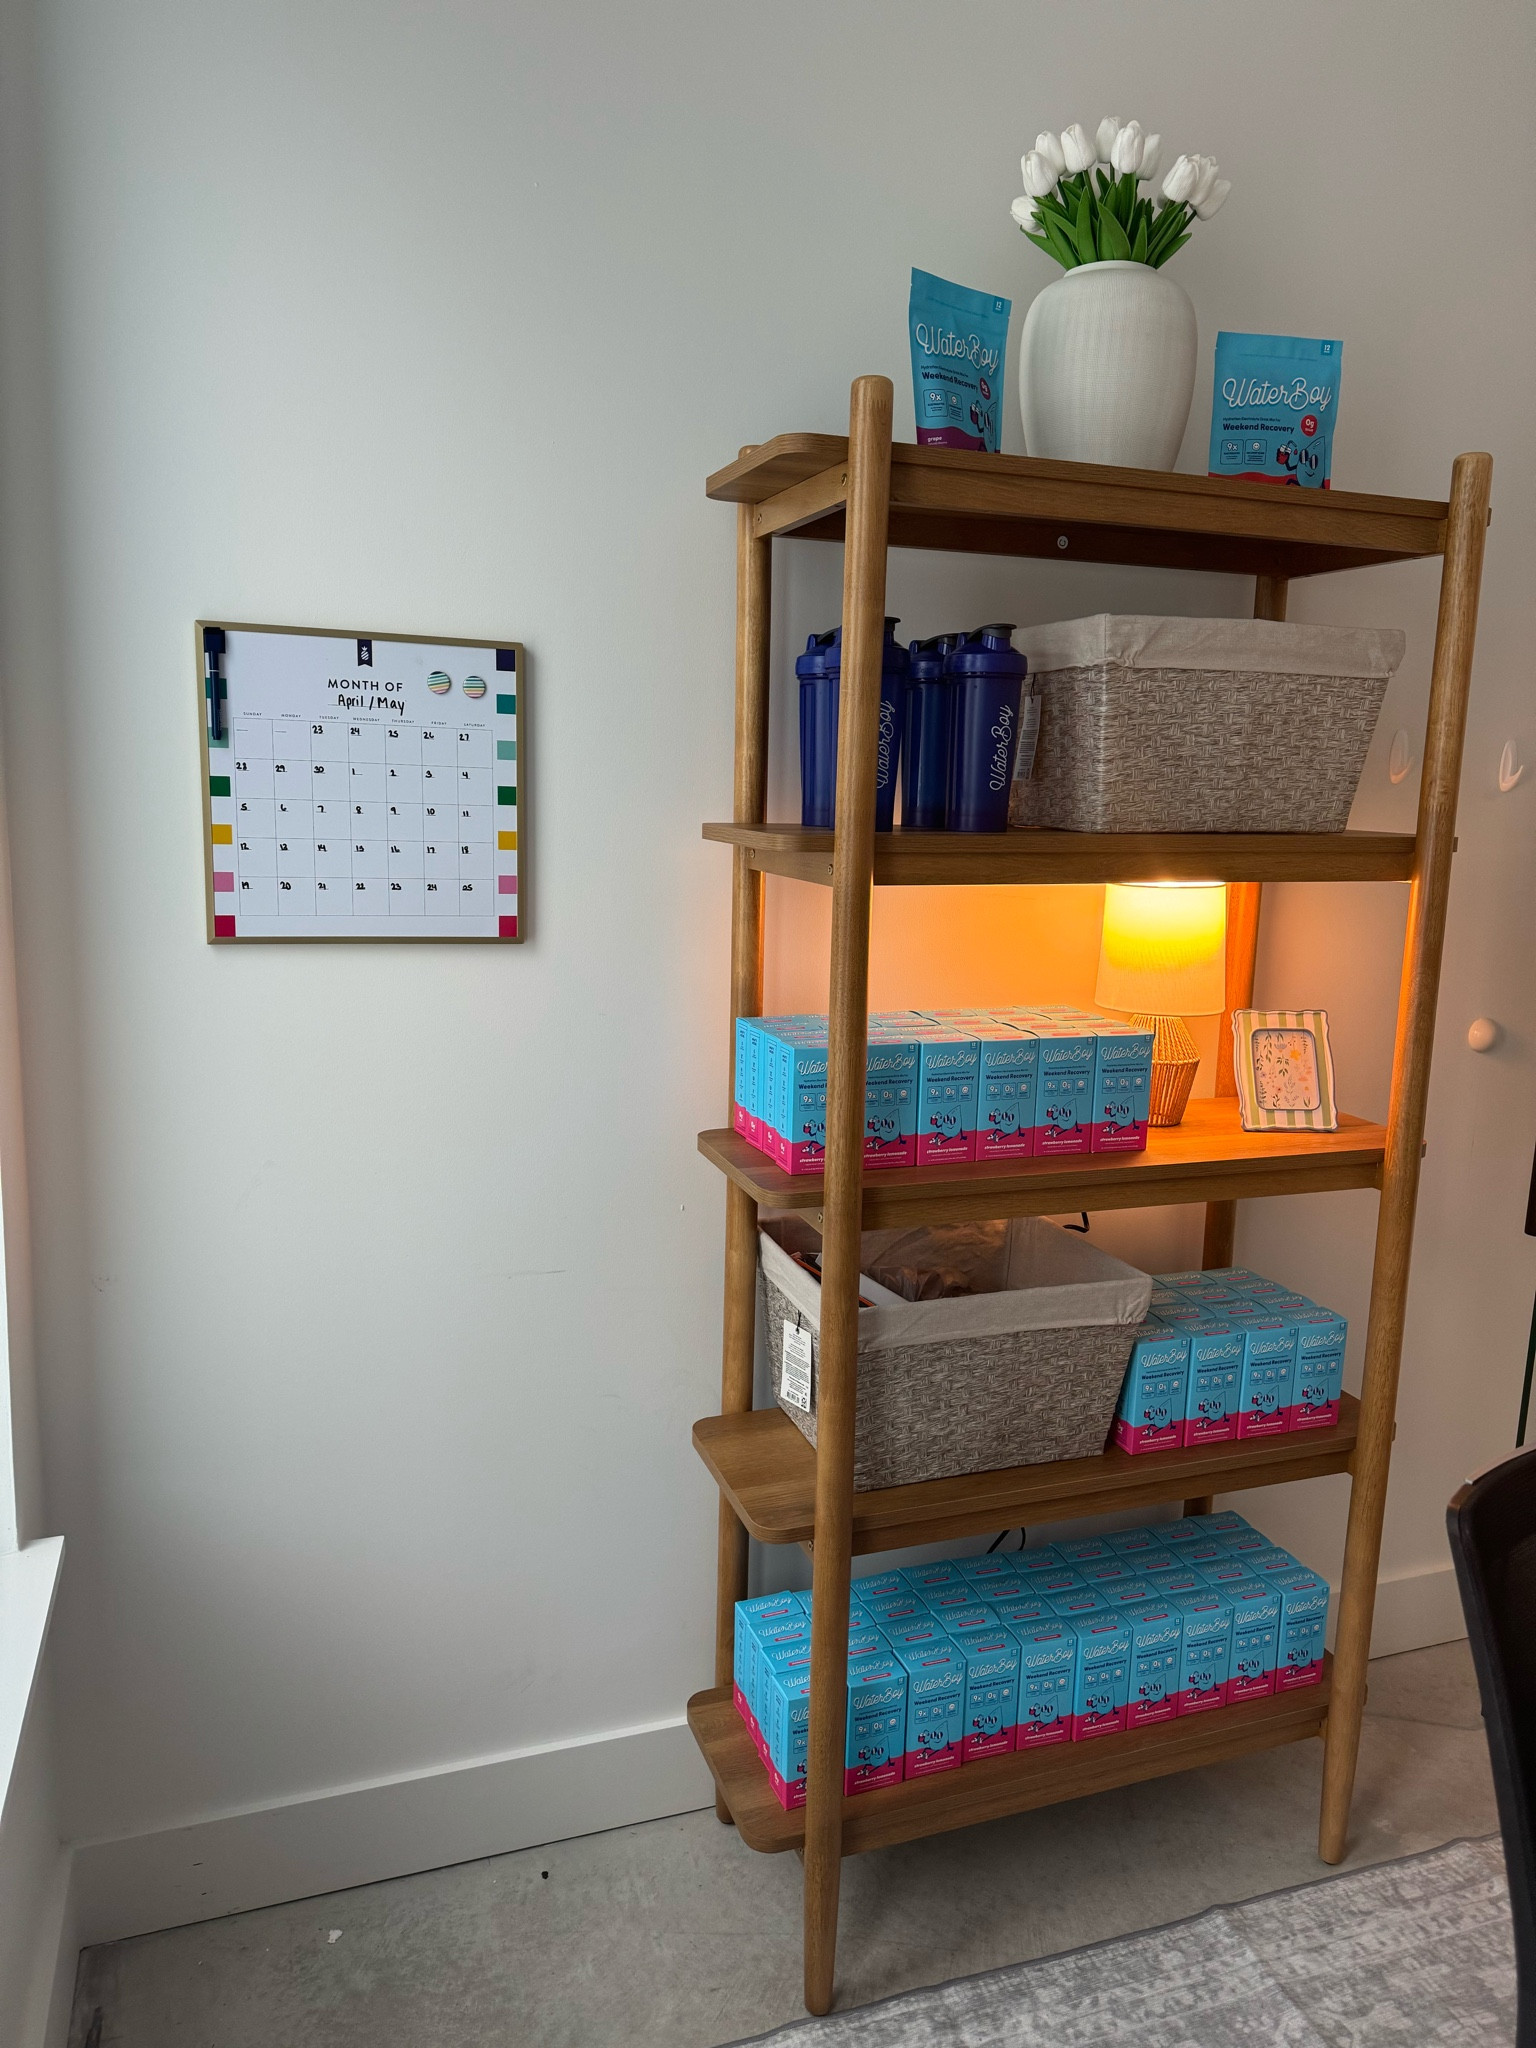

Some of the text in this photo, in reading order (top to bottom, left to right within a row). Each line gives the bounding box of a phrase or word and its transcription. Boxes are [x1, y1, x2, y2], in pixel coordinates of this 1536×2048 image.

[916, 323, 999, 376] WaterBoy
[921, 372, 953, 383] Weekend
[929, 392, 942, 401] 9x
[1222, 377, 1332, 411] WaterBoy
[1223, 423, 1259, 431] Weekend
[1260, 423, 1294, 434] Recovery
[1227, 442, 1238, 451] 9x
[327, 679, 404, 692] MONTH OF
[312, 725, 470, 741] 23 24 25 26 27
[989, 704, 1014, 791] WaterBoy
[313, 766, 325, 774] 30
[425, 770, 433, 778] 3
[462, 771, 469, 779] 4
[240, 803, 248, 811] 5
[280, 804, 287, 812] 6
[355, 806, 362, 814] 8
[390, 806, 397, 814] 9
[279, 881, 292, 890] 20
[390, 882, 402, 890] 23
[427, 883, 438, 891] 24
[985, 1048, 1036, 1067] WaterBoy
[1043, 1045, 1093, 1063] WaterBoy
[1101, 1042, 1151, 1061] WaterBoy
[925, 1050, 977, 1069] WaterBoy
[867, 1091, 876, 1099] 9x
[930, 1088, 939, 1096] 9x
[989, 1085, 998, 1093] 9x
[803, 1095, 812, 1103] 9x
[1250, 1337, 1296, 1355] WaterBoy
[1301, 1331, 1345, 1349] WaterBoy
[1141, 1348, 1188, 1368] WaterBoy
[1197, 1342, 1242, 1362] WaterBoy
[1164, 1370, 1185, 1378] Recovery
[1286, 1596, 1328, 1615] WaterBoy
[1235, 1605, 1279, 1625] WaterBoy
[1306, 1615, 1324, 1623] Recovery
[1186, 1617, 1231, 1637] WaterBoy
[1236, 1625, 1275, 1636] Weekend Recovery
[1136, 1627, 1181, 1648] WaterBoy
[1207, 1637, 1228, 1646] Recovery
[1084, 1639, 1130, 1659] WaterBoy
[1137, 1647, 1178, 1660] Weekend Recovery
[1025, 1648, 1073, 1668] WaterBoy
[968, 1658, 1018, 1679] WaterBoy
[1026, 1668, 1071, 1680] Weekend Recovery
[1084, 1663, 1106, 1672] Weekend
[913, 1672, 964, 1694] WaterBoy
[970, 1679, 1015, 1691] Weekend Recovery
[854, 1687, 904, 1710] WaterBoy
[914, 1693, 961, 1706] Weekend Recovery
[855, 1707, 902, 1722] Weekend Recovery
